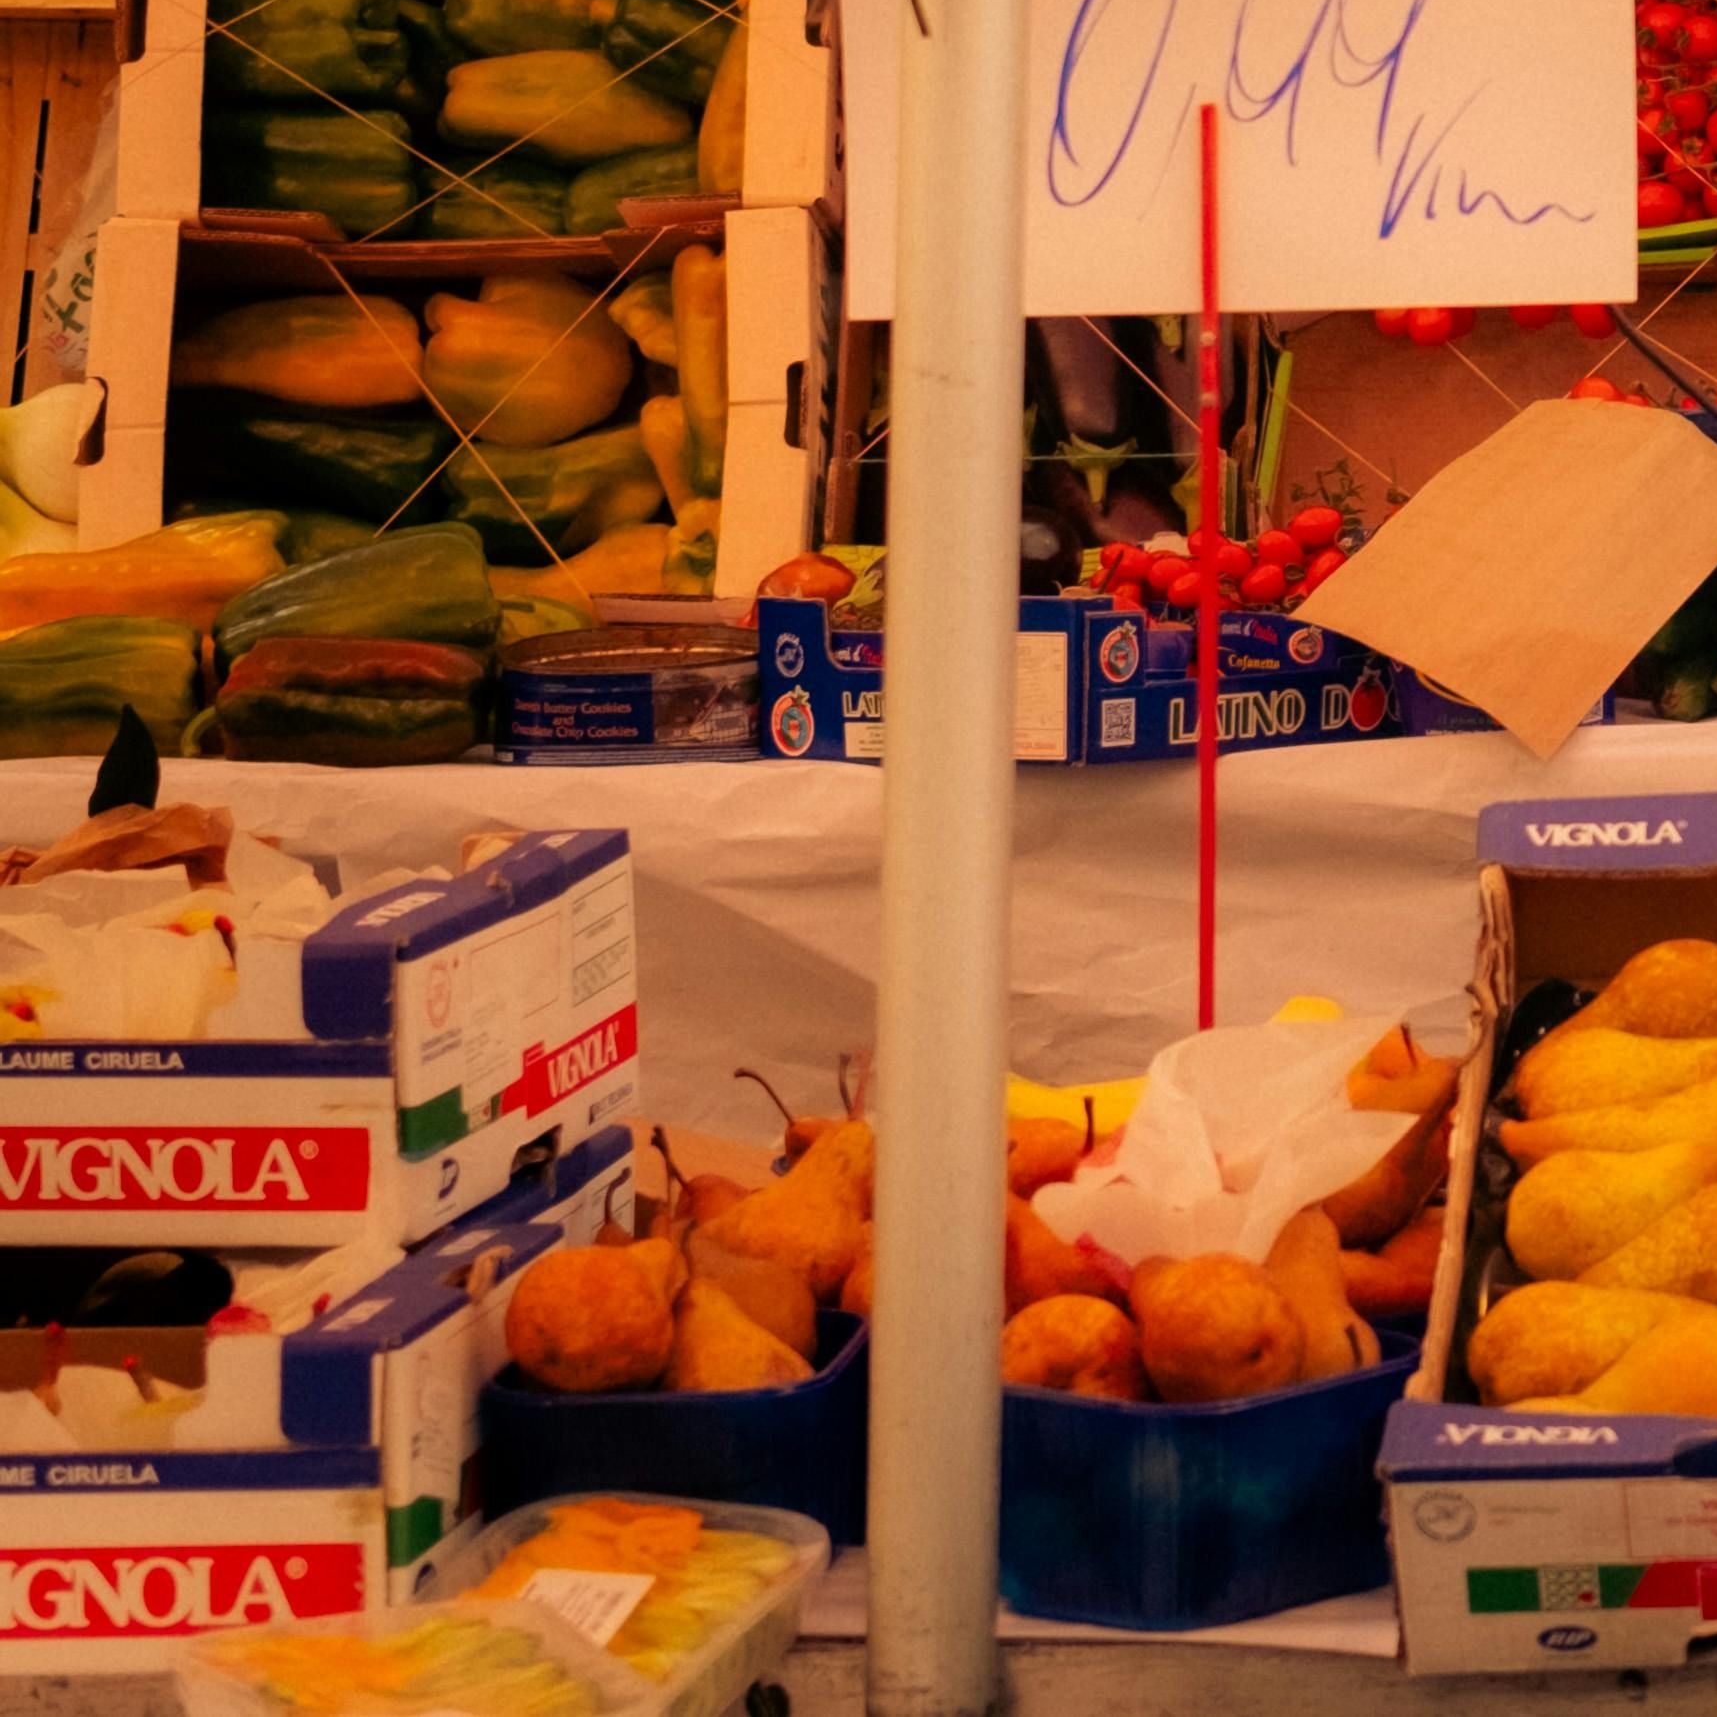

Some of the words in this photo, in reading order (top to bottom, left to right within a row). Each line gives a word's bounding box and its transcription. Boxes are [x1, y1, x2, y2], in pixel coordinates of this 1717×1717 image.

[580, 701, 633, 714] Cookies
[1168, 688, 1306, 746] LTINO
[552, 714, 575, 727] and
[555, 725, 585, 741] Chip
[586, 725, 640, 738] Cookies
[1524, 820, 1683, 848] VIGNOLA
[84, 1051, 185, 1071] CIRUELA
[546, 1021, 619, 1100] VIGNOLA
[1443, 1422, 1619, 1446] VIGNOLA
[45, 1463, 161, 1486] CIRUELA
